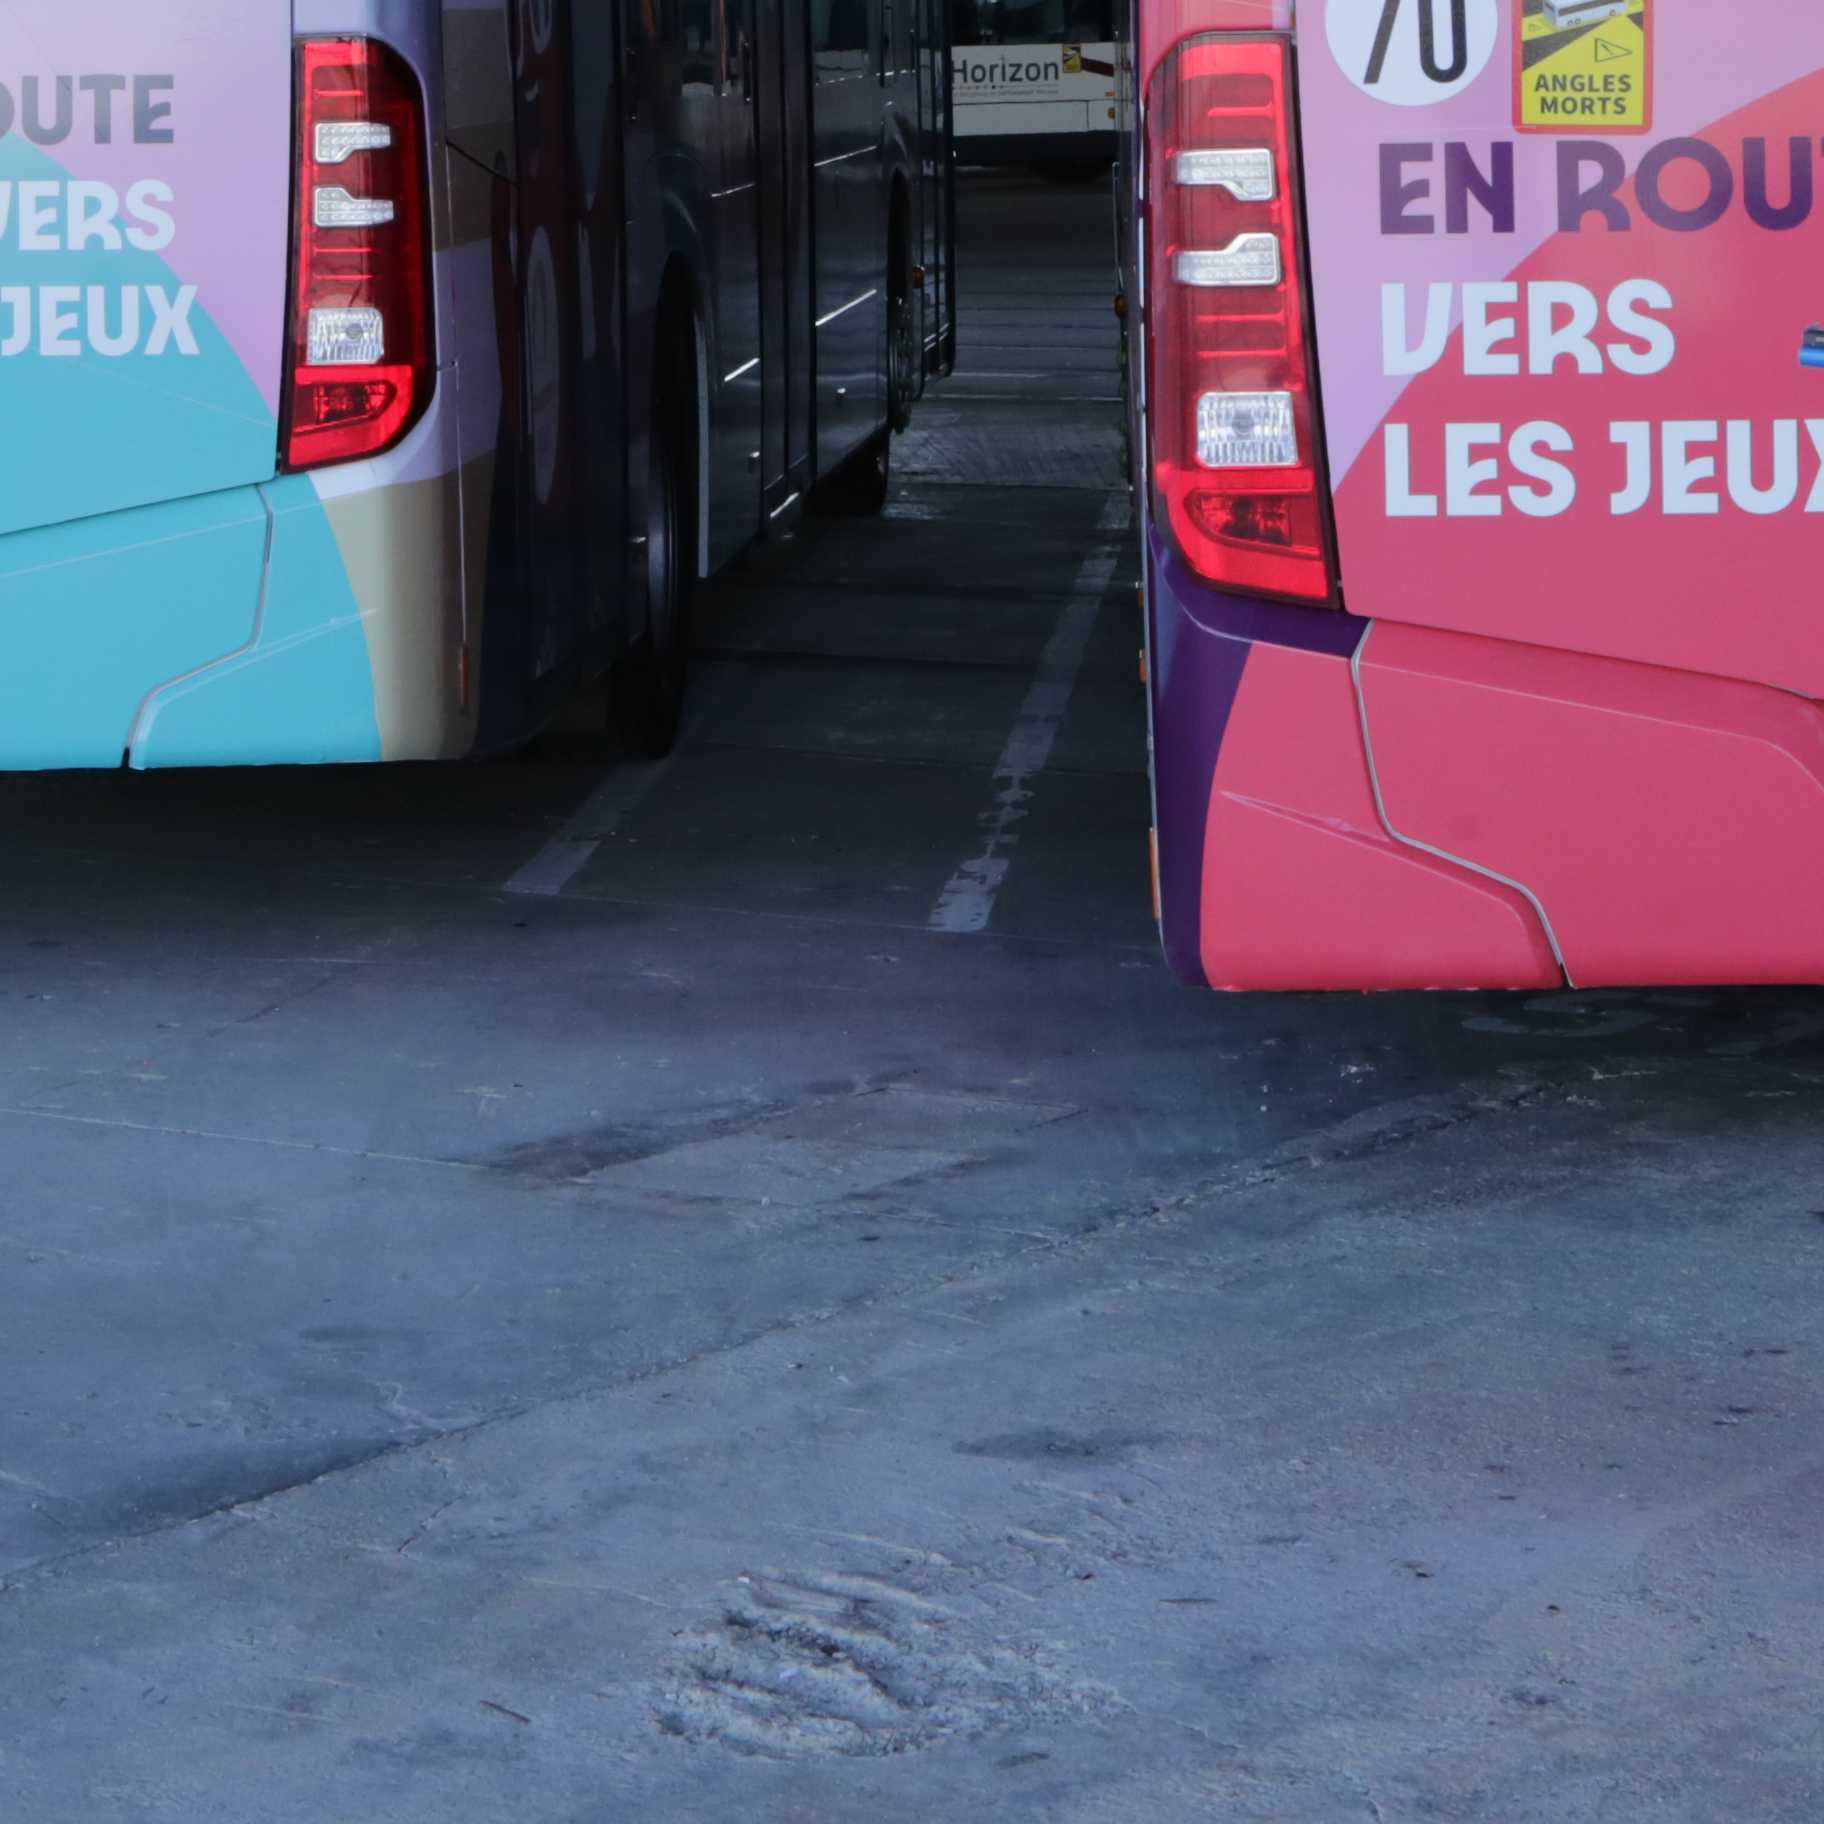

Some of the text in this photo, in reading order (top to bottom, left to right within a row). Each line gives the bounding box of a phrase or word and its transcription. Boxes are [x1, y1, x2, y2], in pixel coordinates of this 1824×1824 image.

[951, 56, 1059, 84] Horizon
[1534, 73, 1632, 97] ANGLES
[1539, 95, 1627, 117] MORTS
[1379, 142, 1515, 236] EN
[1, 283, 200, 358] JEUX
[1382, 278, 1675, 378] VERS
[1383, 419, 1576, 520] LES
